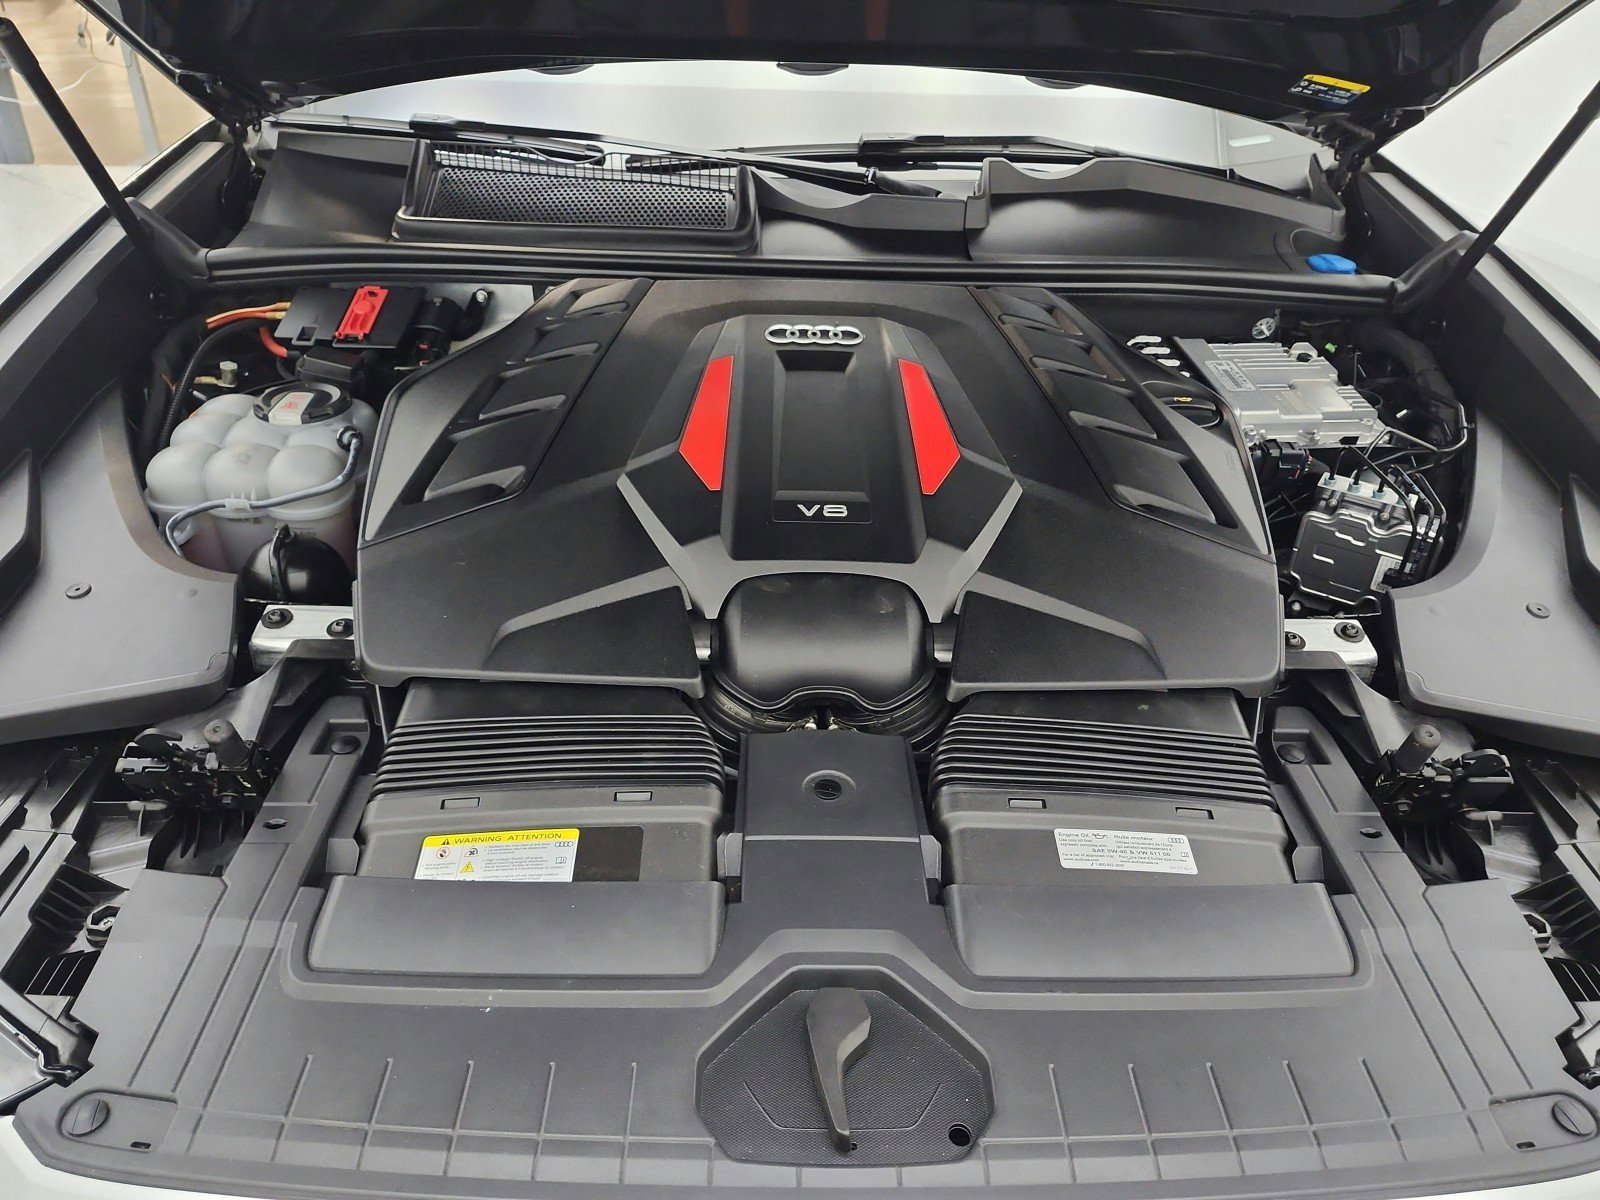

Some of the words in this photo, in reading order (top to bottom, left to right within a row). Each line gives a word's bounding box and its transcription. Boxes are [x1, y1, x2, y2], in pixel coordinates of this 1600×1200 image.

[797, 504, 848, 517] V8
[454, 835, 502, 844] WARNING
[507, 832, 562, 841] ATTENTION
